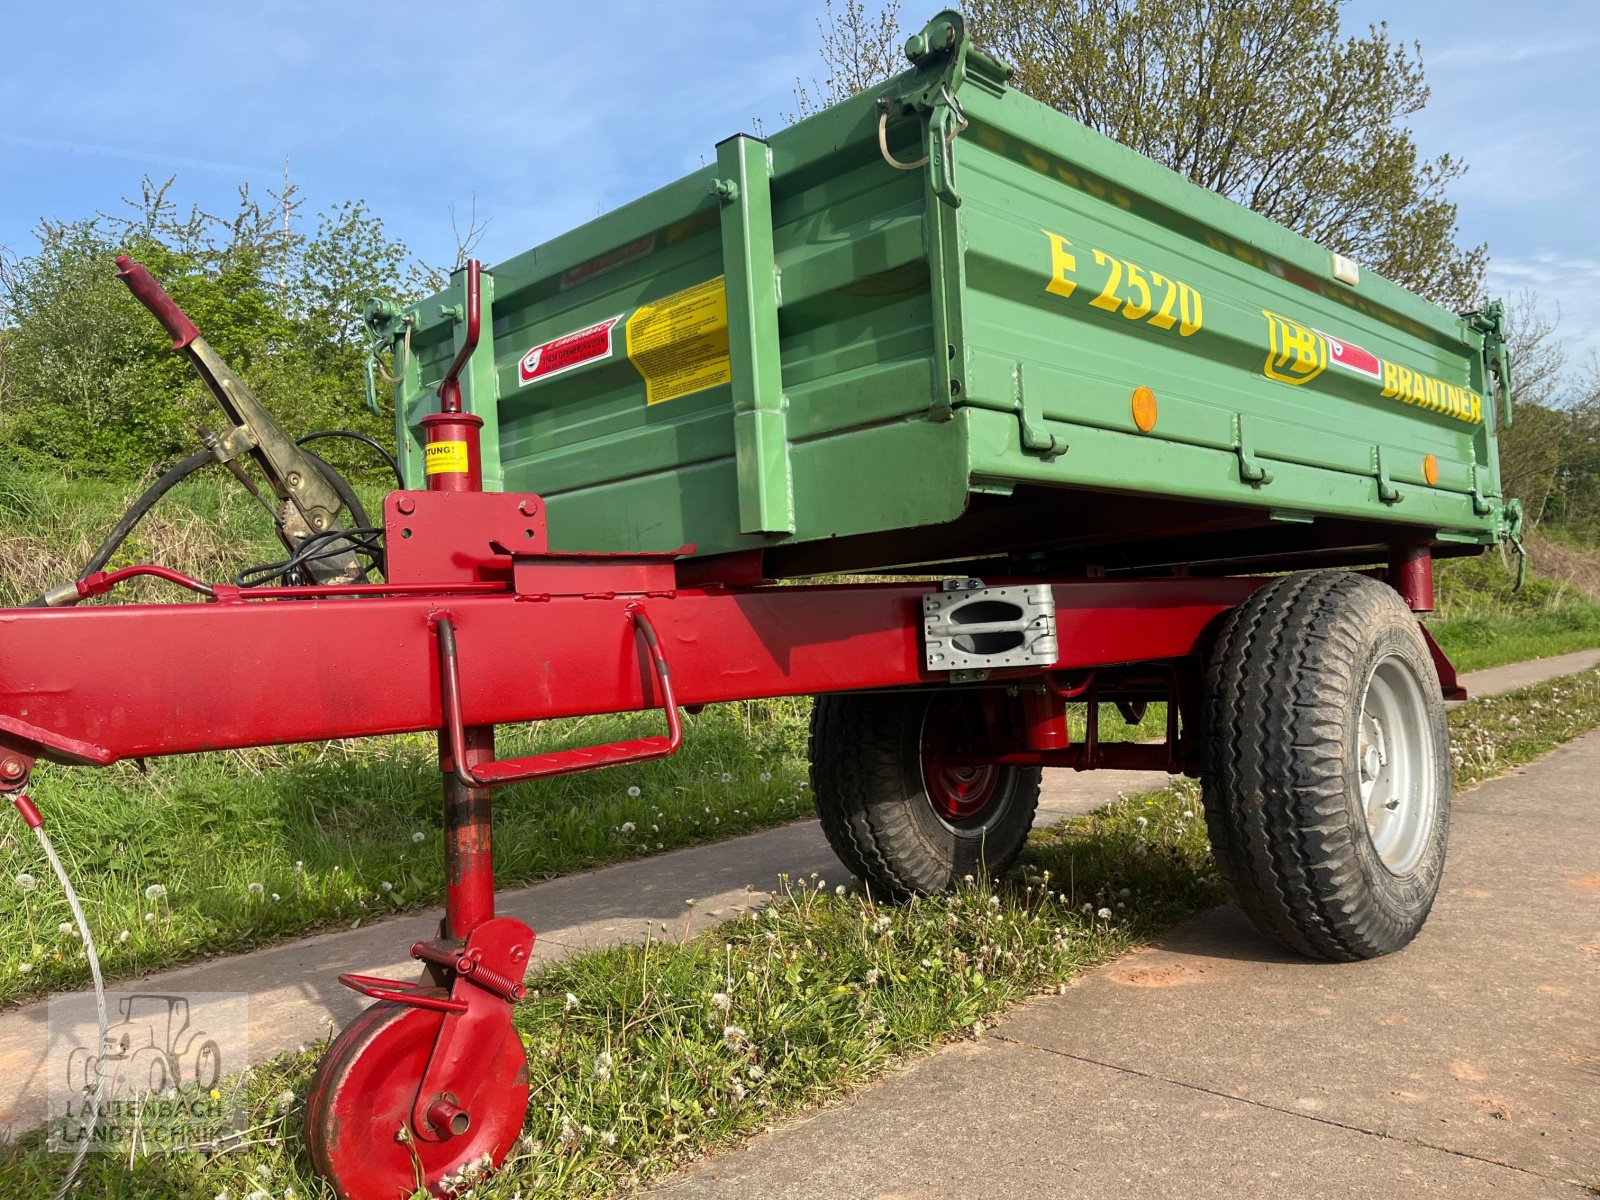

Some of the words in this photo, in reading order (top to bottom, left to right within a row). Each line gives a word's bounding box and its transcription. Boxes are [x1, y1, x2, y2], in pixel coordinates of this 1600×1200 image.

[1041, 229, 1077, 298] E
[1088, 249, 1203, 336] 2520
[1380, 359, 1482, 425] BRANTNER
